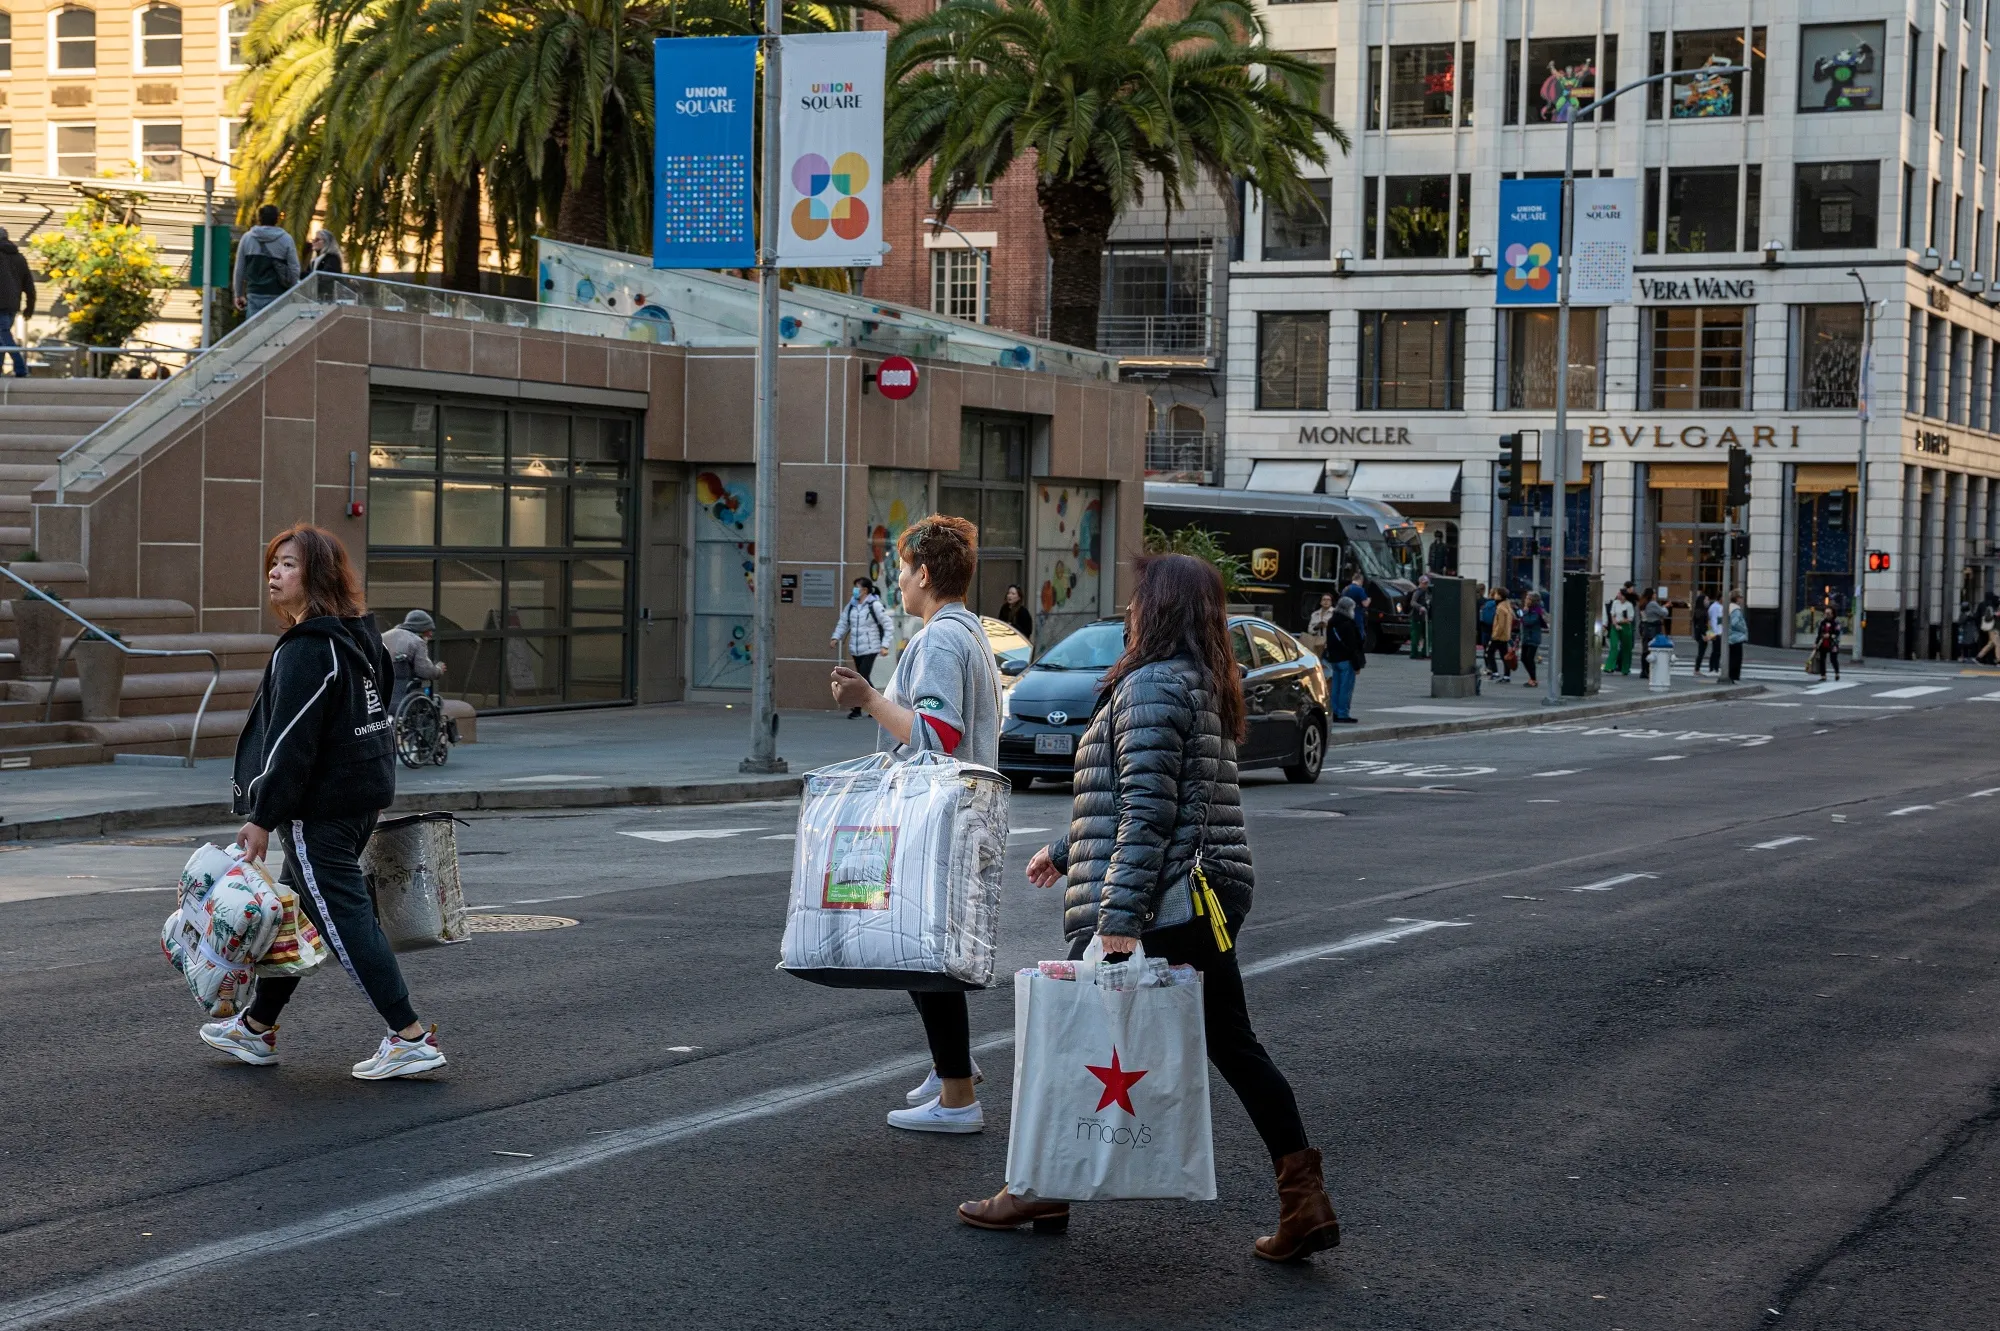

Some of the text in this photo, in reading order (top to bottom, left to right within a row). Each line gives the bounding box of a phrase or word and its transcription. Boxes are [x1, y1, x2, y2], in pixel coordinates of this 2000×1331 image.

[685, 86, 727, 98] UNION
[812, 82, 853, 94] UNION
[675, 98, 737, 117] SQUARE
[801, 95, 863, 113] SQUARE
[1511, 212, 1547, 222] SQUARE
[1586, 211, 1621, 220] SQUARE
[1640, 277, 1755, 300] VERA WANG
[1299, 426, 1412, 445] MONCLER
[1588, 425, 1800, 448] BVLGARI
[1254, 558, 1277, 576] ups
